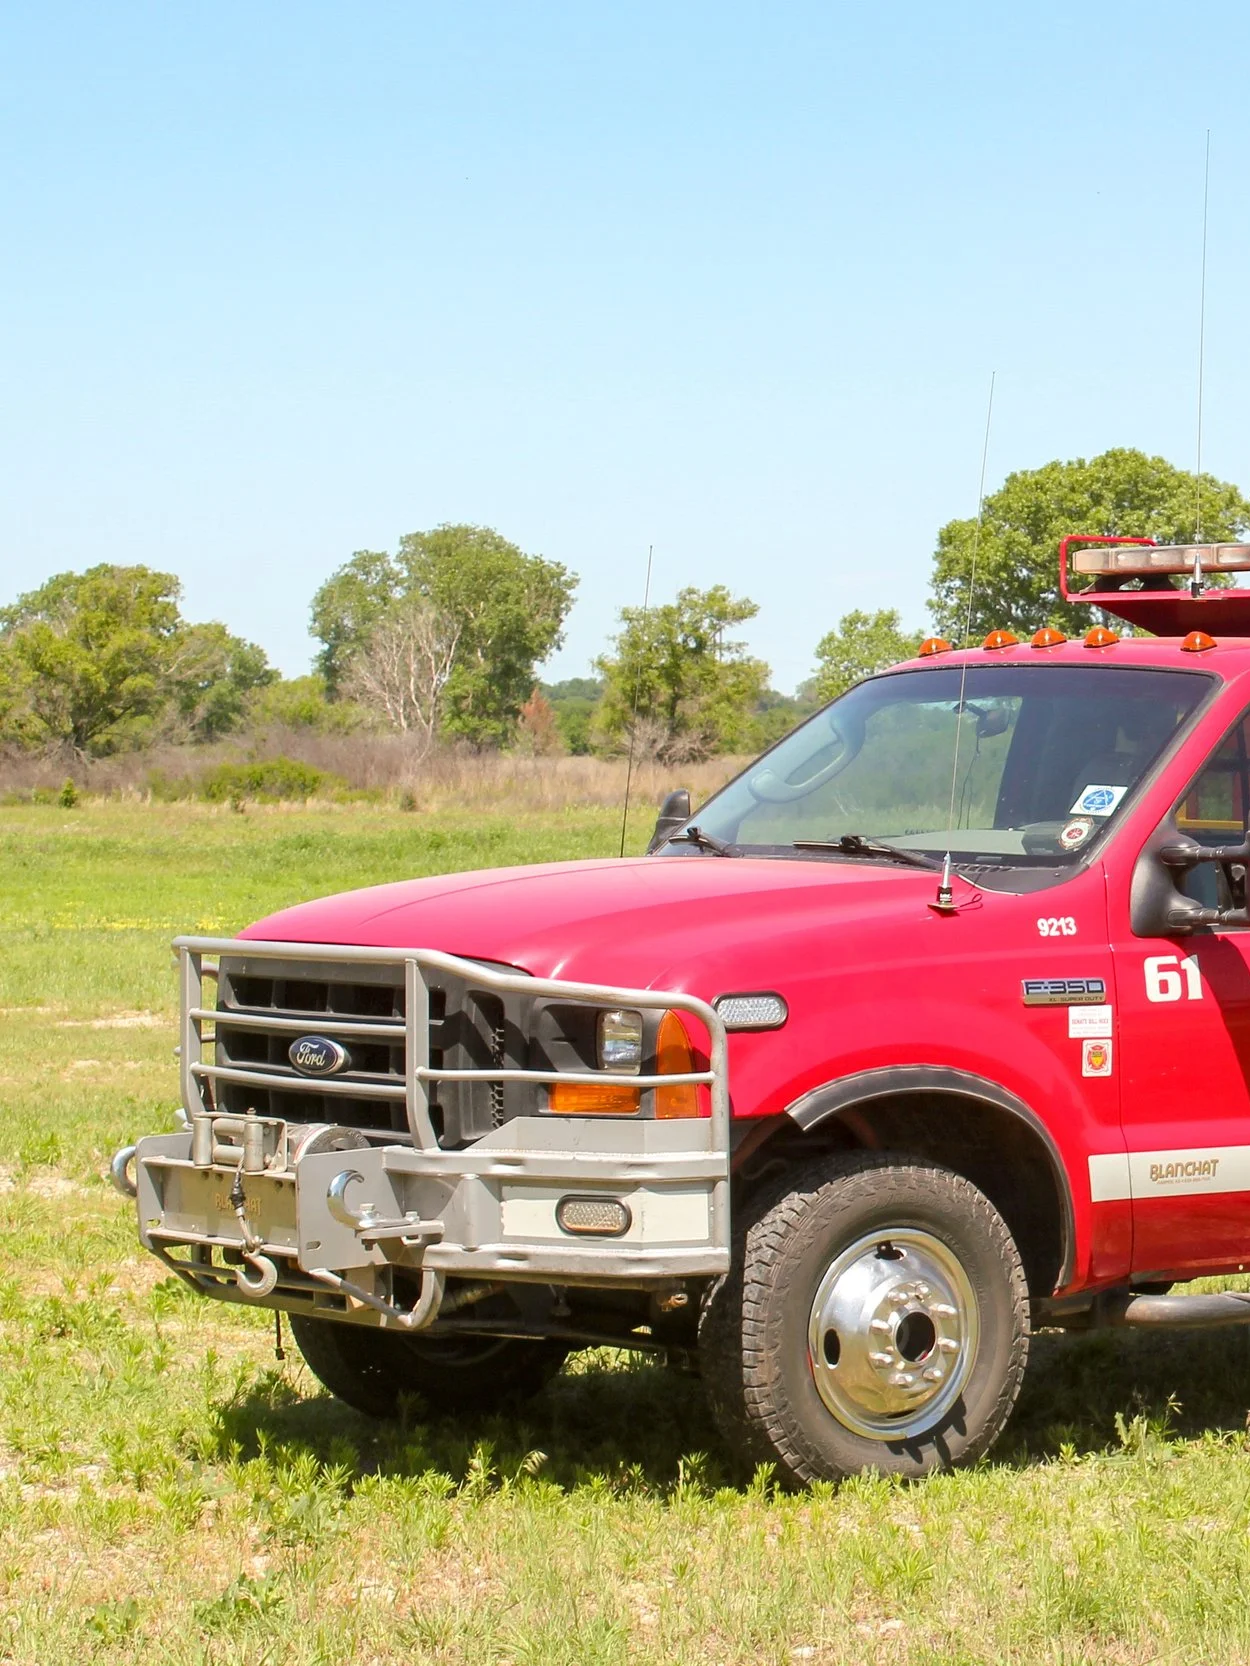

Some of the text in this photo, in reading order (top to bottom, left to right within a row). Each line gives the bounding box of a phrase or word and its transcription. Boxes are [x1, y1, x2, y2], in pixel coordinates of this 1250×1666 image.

[1037, 916, 1077, 937] 9213
[1024, 980, 1104, 995] F-350
[1143, 954, 1203, 1003] 61
[296, 1041, 326, 1066] Ford
[1150, 1159, 1219, 1182] BLANCHAT
[215, 1192, 261, 1216] BLAHAT
